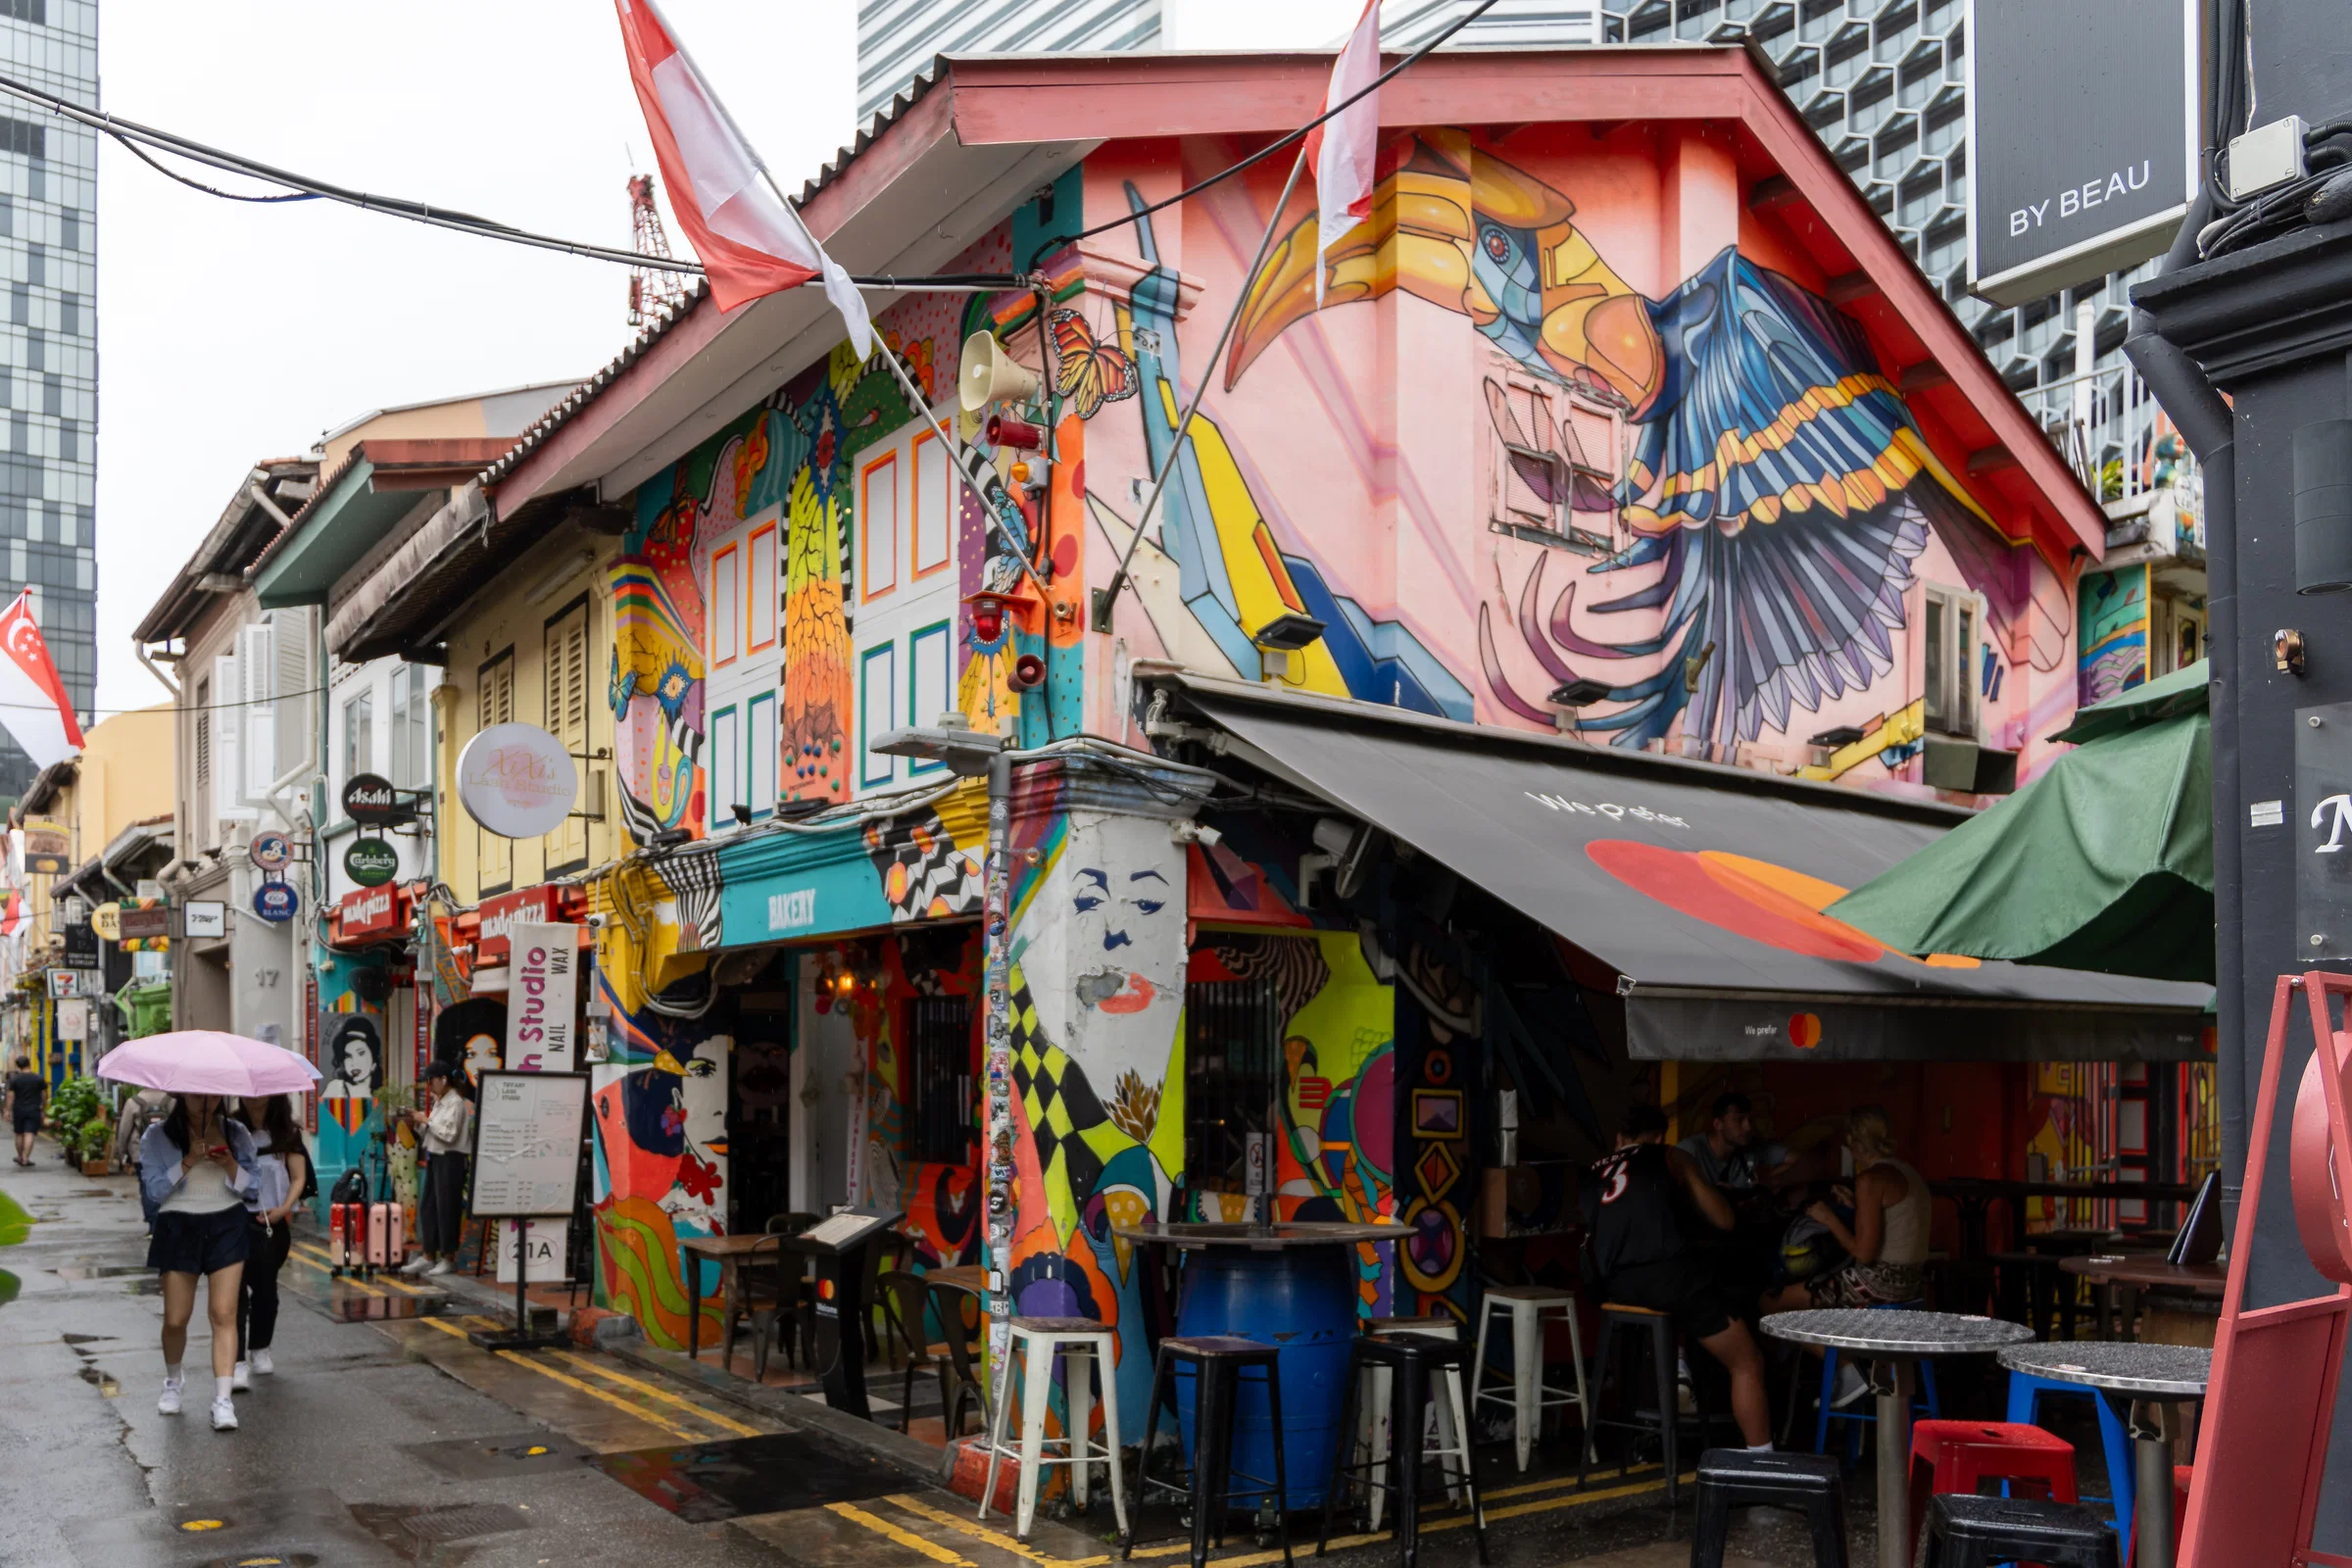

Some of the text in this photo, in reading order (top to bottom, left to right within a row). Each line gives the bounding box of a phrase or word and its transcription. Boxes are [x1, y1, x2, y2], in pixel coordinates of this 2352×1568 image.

[2010, 160, 2149, 237] BY BEAU
[348, 787, 391, 805] Asahi
[467, 772, 571, 796] Lash Studio
[1524, 791, 1690, 829] We pefer
[349, 852, 395, 869] Carlsberg
[768, 888, 816, 931] BAKERY
[551, 948, 568, 975] WAX
[255, 968, 280, 988] 17
[518, 947, 546, 1043] Studio
[548, 1023, 565, 1053] NAIL
[1744, 1024, 1778, 1037] We prefer
[1600, 1159, 1631, 1204] 3
[512, 1242, 552, 1259] 21A
